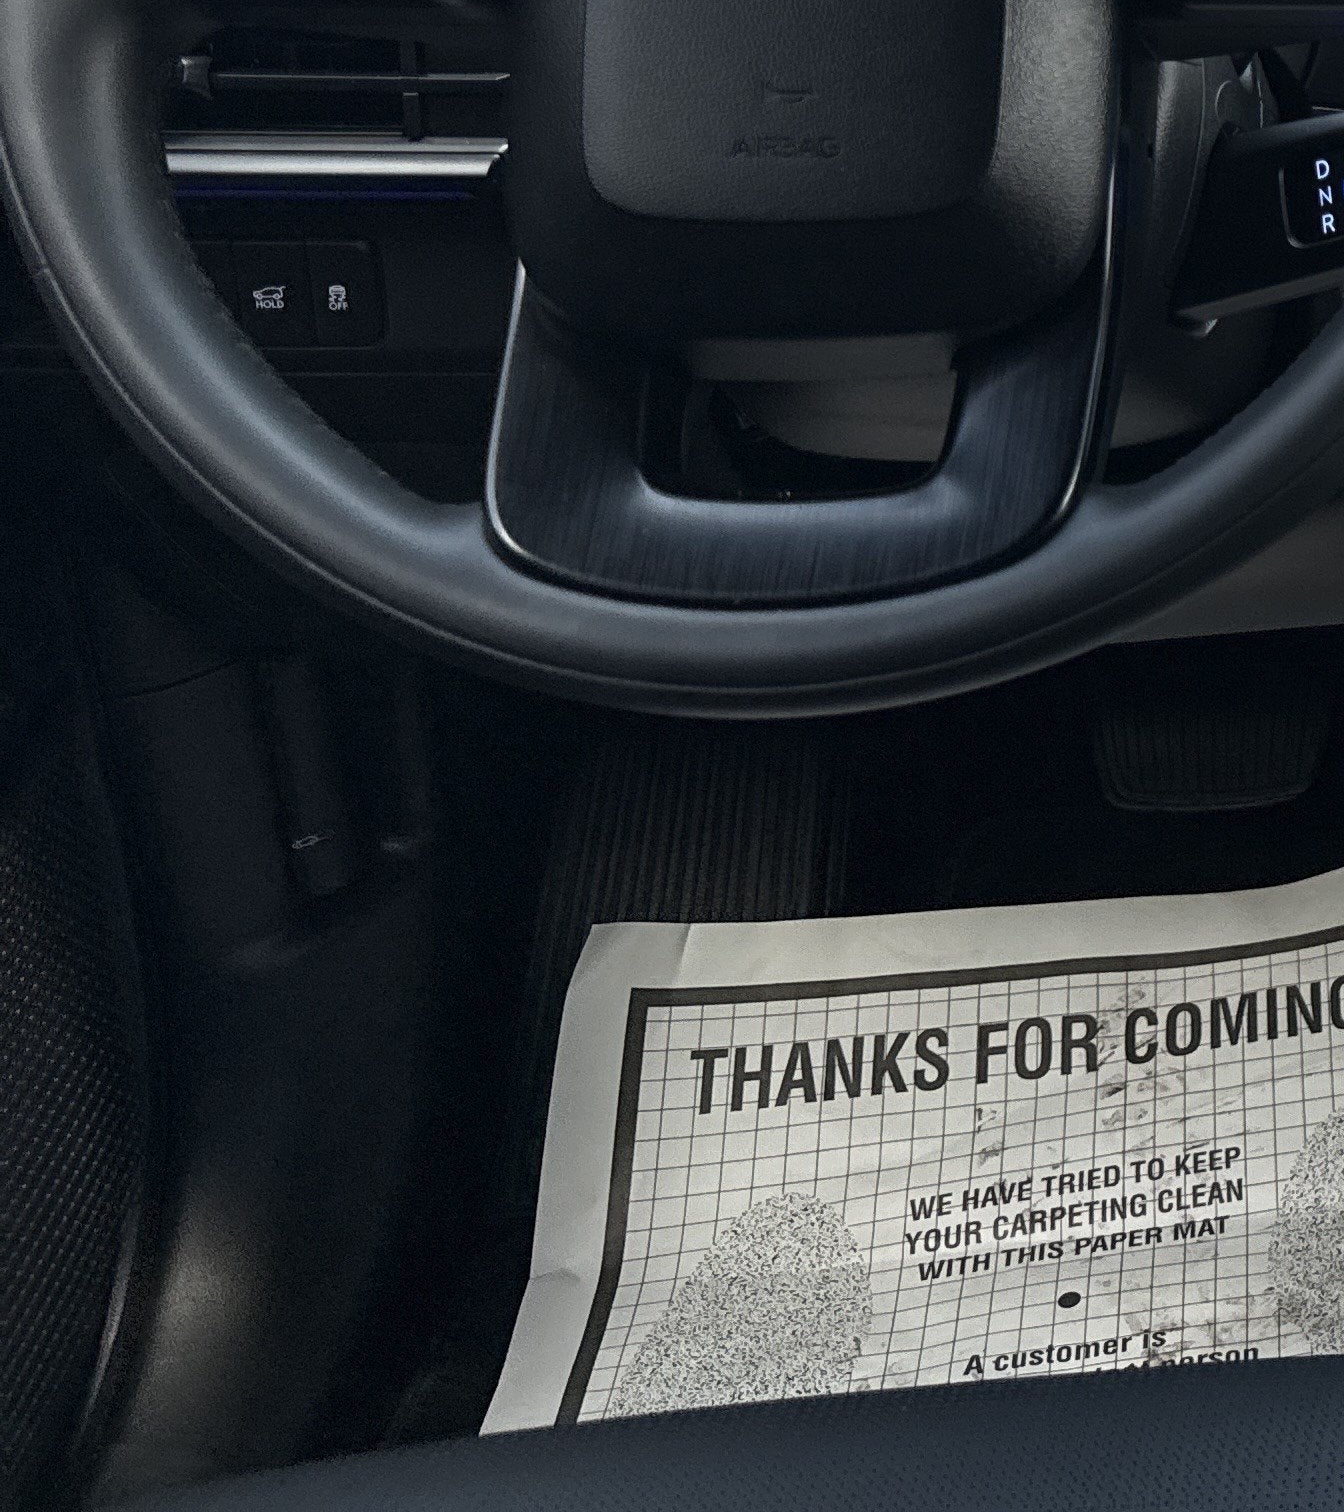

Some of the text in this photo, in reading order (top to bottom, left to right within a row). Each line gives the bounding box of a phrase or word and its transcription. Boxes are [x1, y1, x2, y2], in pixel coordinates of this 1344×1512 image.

[1315, 159, 1330, 180] D
[1319, 185, 1333, 206] N
[1322, 213, 1336, 234] R
[255, 299, 285, 309] HOLD
[328, 301, 348, 311] OFF
[690, 1027, 950, 1115] THANKS
[976, 1017, 1099, 1084] FOR
[909, 1146, 1241, 1221] WE HAVE TRIED TO KEEP
[904, 1178, 1244, 1255] YOUR CARPETING CLEAN
[918, 1216, 1230, 1281] WITH THIS PAPER MAT
[963, 1354, 983, 1376] A
[994, 1336, 1132, 1371] customer
[1141, 1329, 1167, 1348] is
